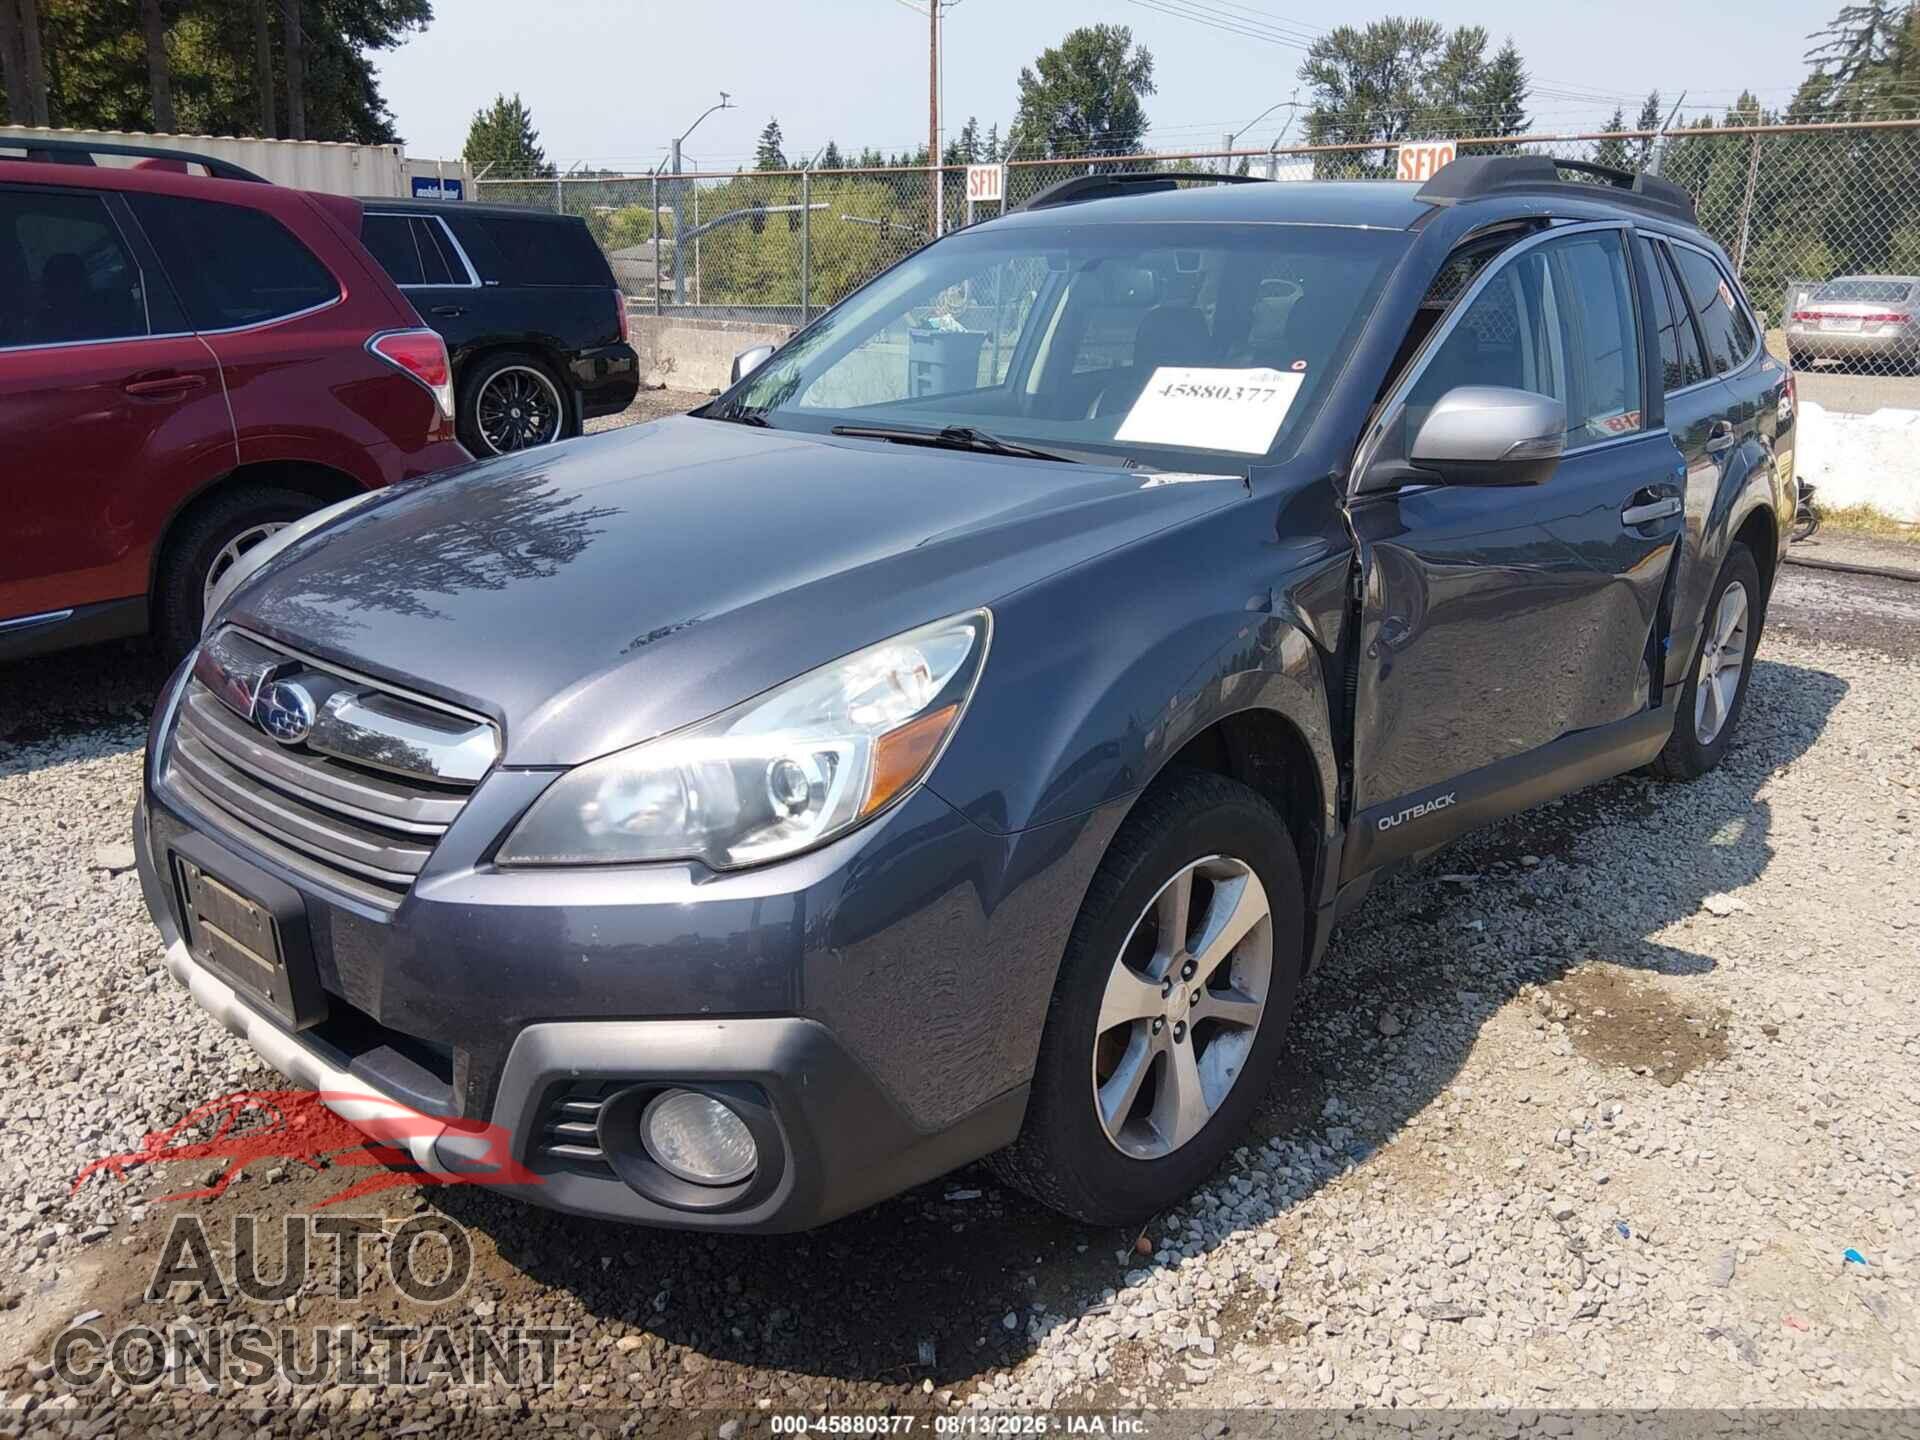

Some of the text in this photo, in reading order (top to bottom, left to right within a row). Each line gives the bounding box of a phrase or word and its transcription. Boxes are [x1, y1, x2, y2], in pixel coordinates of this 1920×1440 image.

[969, 169, 999, 197] SF11
[1158, 383, 1277, 402] 45880377
[1378, 792, 1457, 831] OUTBACK
